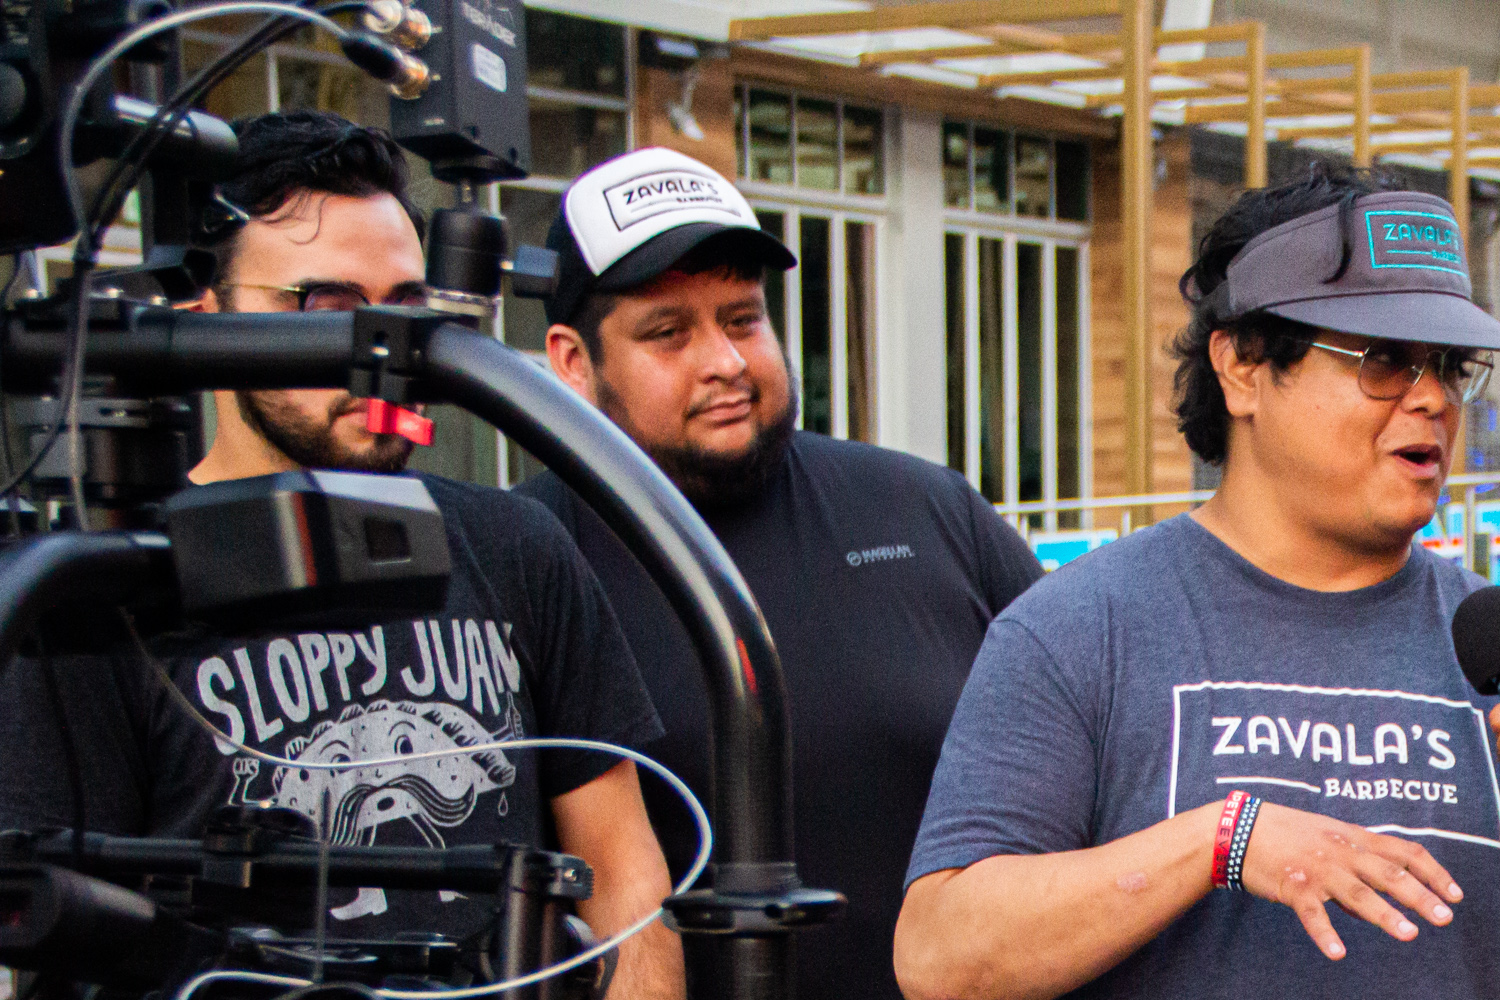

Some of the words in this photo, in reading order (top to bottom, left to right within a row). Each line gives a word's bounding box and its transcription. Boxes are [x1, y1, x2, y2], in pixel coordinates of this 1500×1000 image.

[622, 178, 719, 206] ZAVALA'S
[197, 624, 388, 756] SLOPPY
[400, 617, 521, 717] JUAN
[1211, 715, 1457, 771] ZAVALA'S
[1324, 777, 1459, 805] BARBECUE
